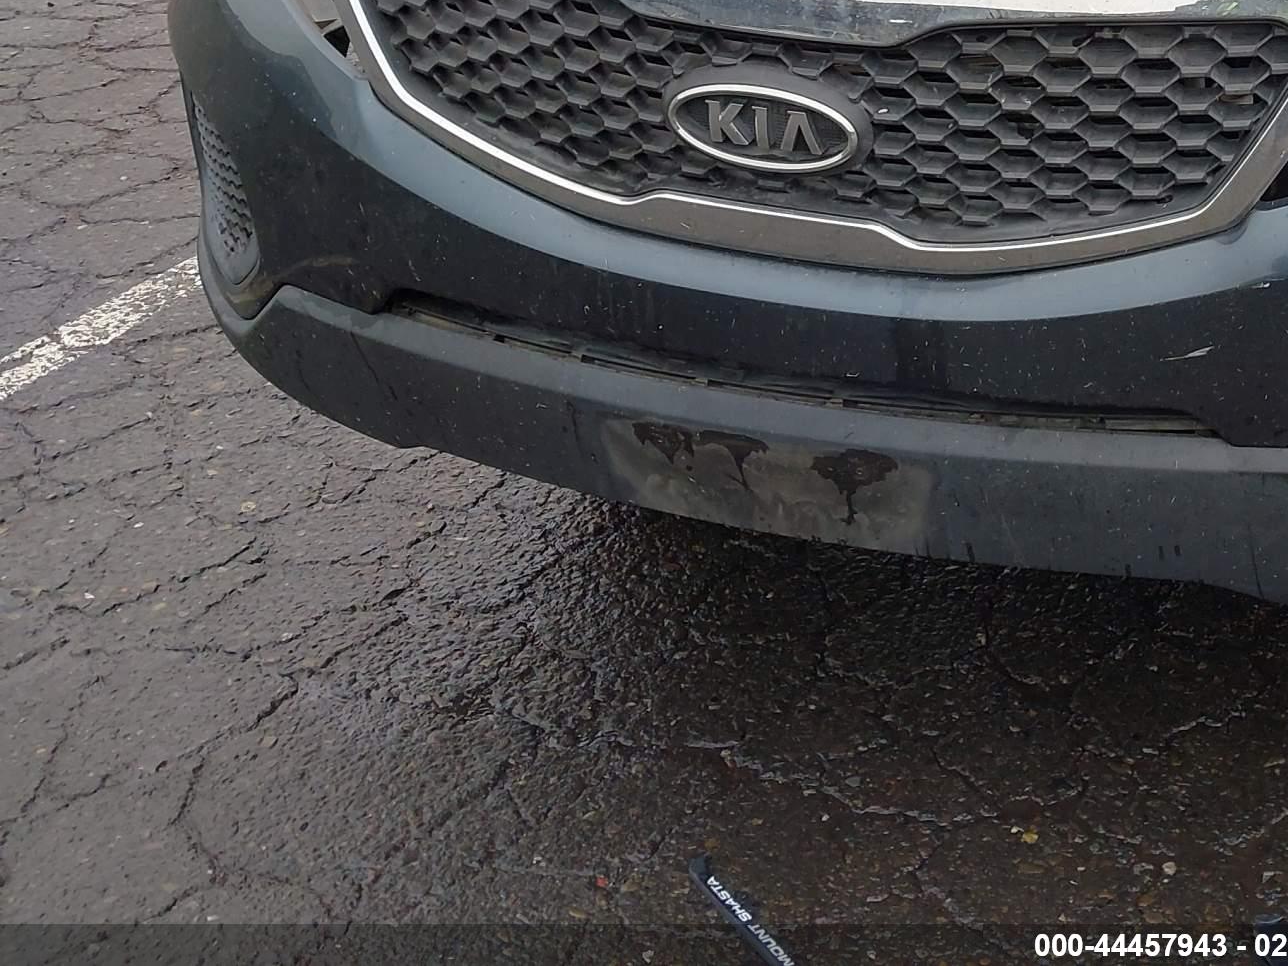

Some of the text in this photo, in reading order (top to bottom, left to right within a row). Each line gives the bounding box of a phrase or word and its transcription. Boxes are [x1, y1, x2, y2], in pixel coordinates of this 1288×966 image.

[705, 100, 823, 155] KIA
[707, 876, 795, 966] MOUNT SHASTA
